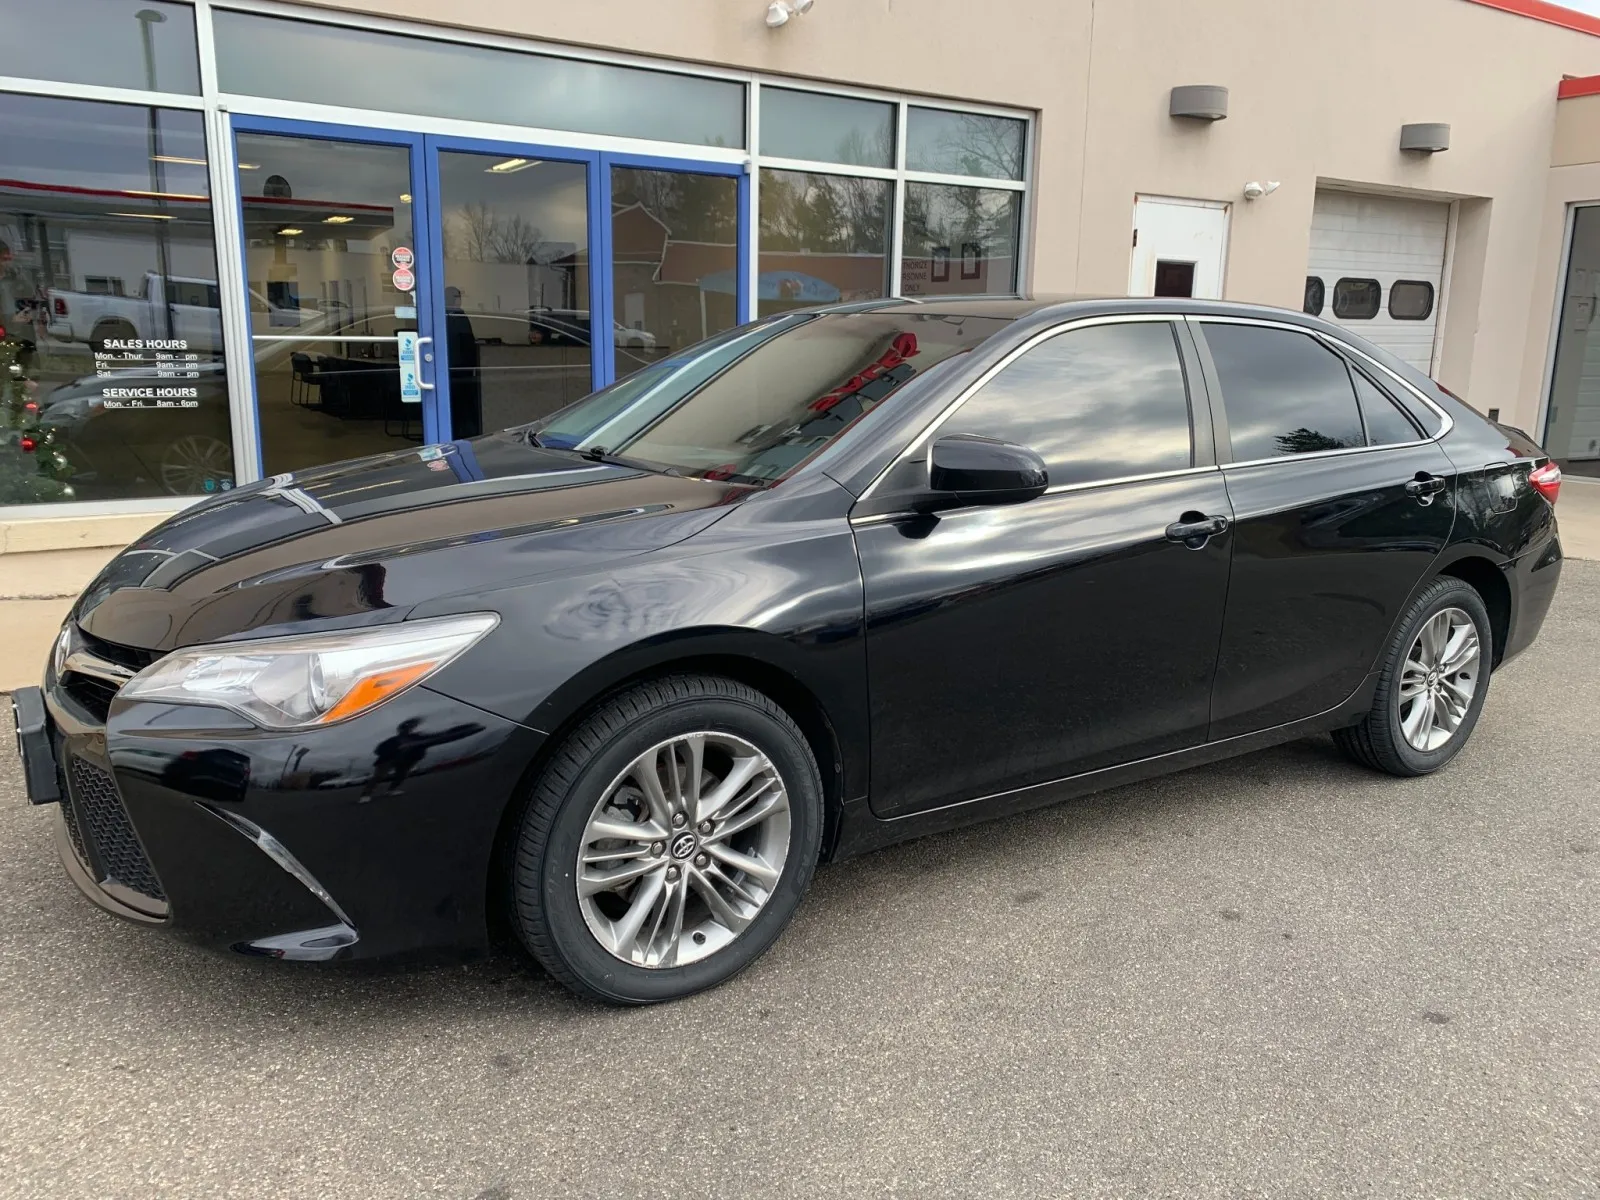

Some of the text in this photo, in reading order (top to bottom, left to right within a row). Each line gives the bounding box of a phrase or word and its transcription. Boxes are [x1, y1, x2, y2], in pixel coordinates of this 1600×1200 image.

[103, 339, 187, 349] SALES HOURS
[94, 352, 116, 360] Mon.
[123, 352, 144, 360] Thur.
[102, 388, 197, 397] SERVICE HOURS
[103, 400, 124, 408] Mon.
[181, 400, 198, 408] 6pm
